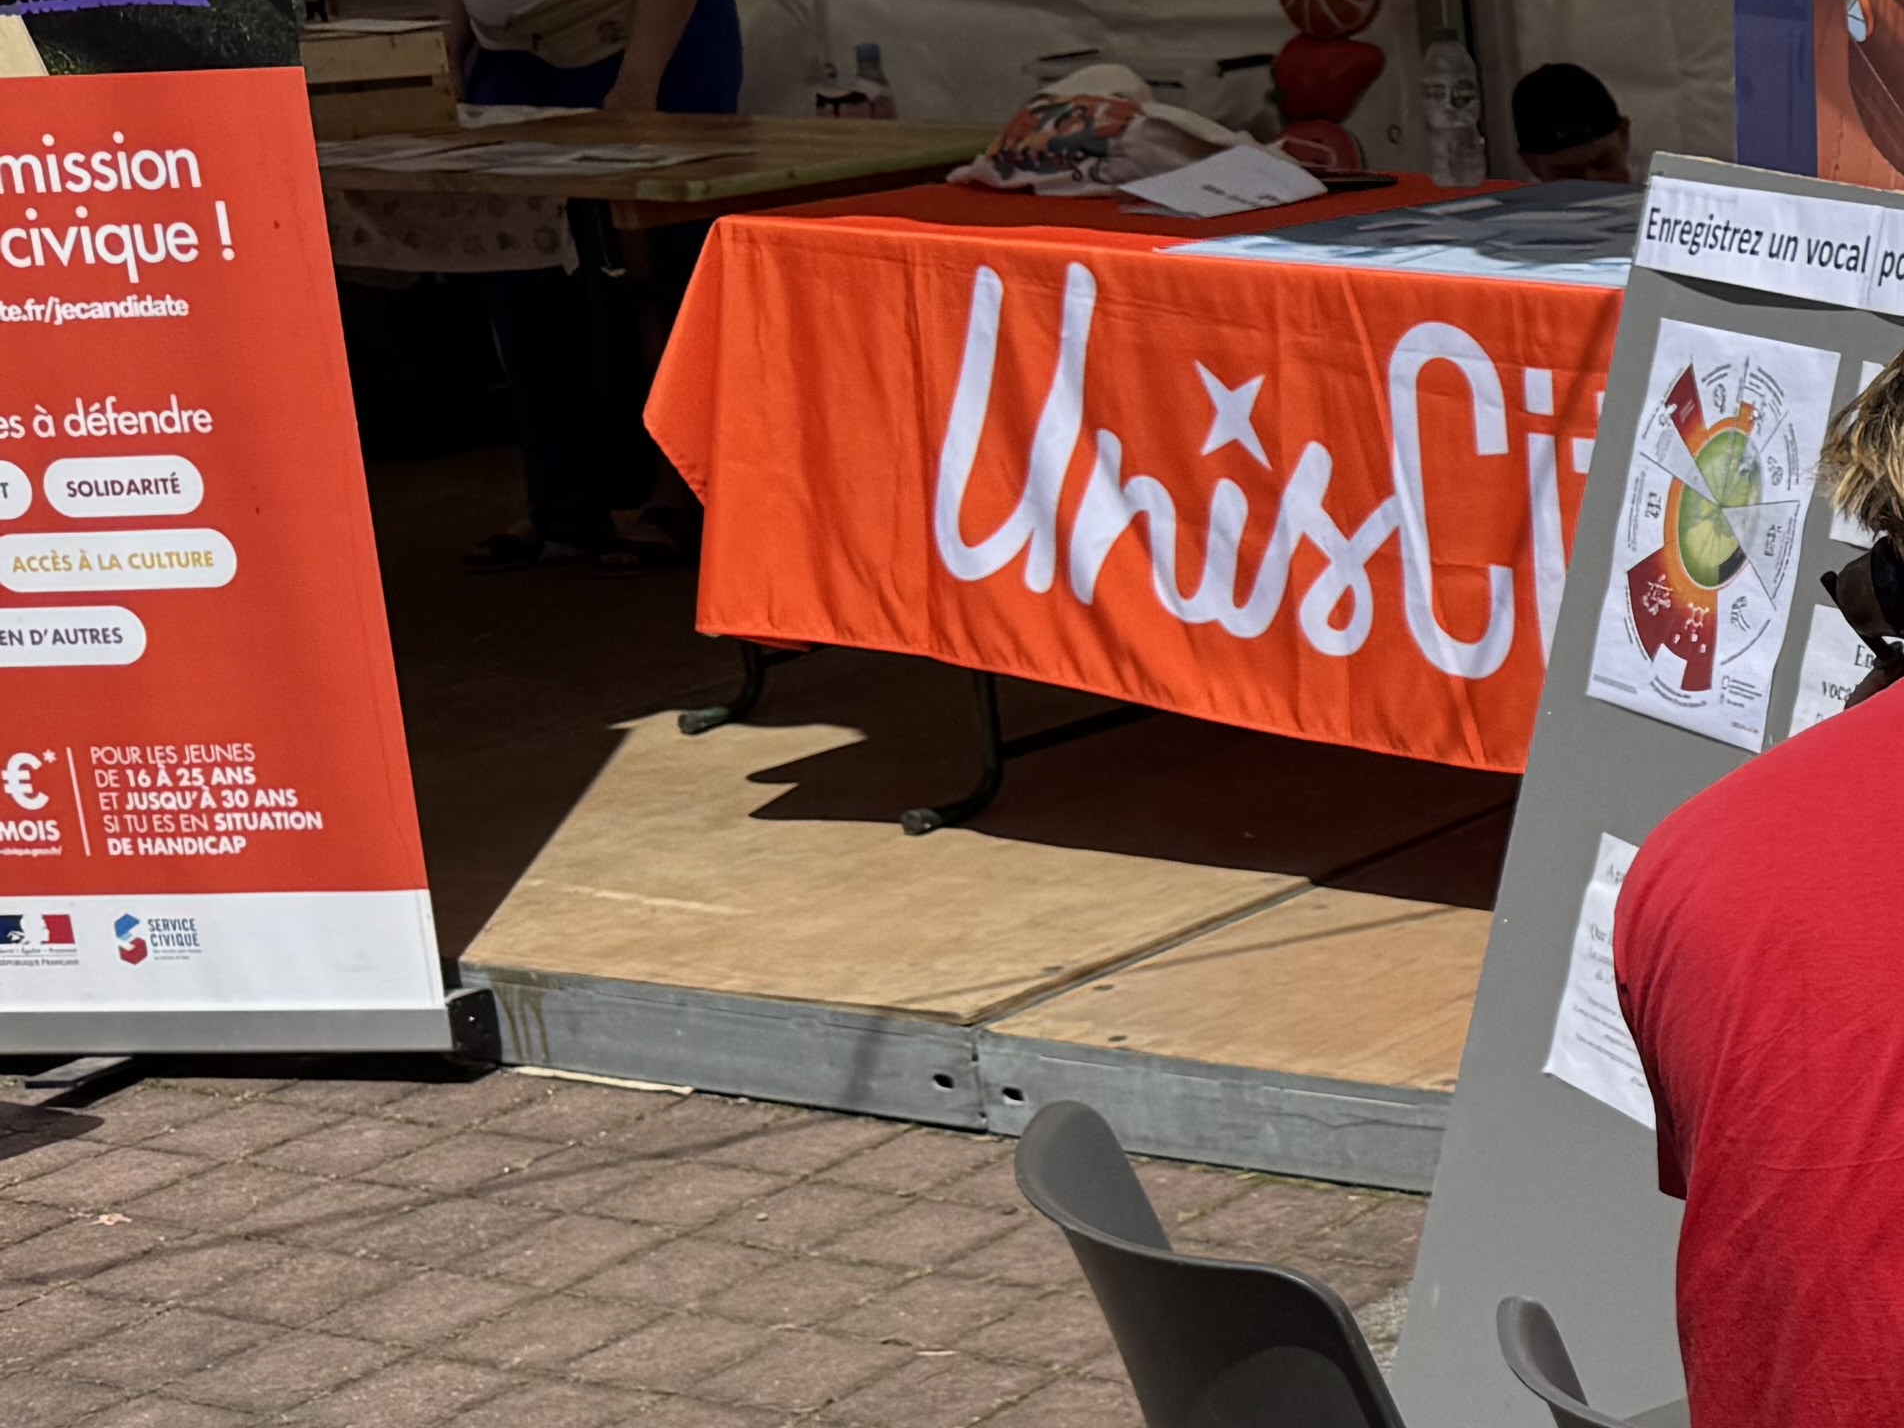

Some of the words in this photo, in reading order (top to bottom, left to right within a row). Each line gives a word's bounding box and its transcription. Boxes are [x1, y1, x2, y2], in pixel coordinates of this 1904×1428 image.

[0, 131, 202, 194] mission
[0, 205, 199, 283] civique
[215, 200, 235, 261] !
[1646, 207, 1761, 256] Enregistrez
[1768, 232, 1798, 262] un
[1806, 235, 1870, 273] vocal
[33, 404, 56, 438] à
[63, 393, 213, 438] défendre
[66, 472, 181, 498] SOLIDARITÉ
[12, 549, 72, 573] ACCÈS
[78, 548, 93, 572] À
[97, 553, 122, 572] LA
[127, 550, 214, 570] CULTURE
[30, 627, 123, 647] D'AUTRES
[90, 745, 143, 765] POUR
[146, 745, 178, 765] LES
[182, 743, 256, 764] JEUNES
[94, 769, 120, 788] DE
[125, 768, 152, 788] 16
[156, 763, 173, 787] À
[176, 768, 205, 786] 25
[210, 766, 257, 785] ANS
[98, 792, 120, 810] ET
[221, 789, 249, 809] 30
[254, 788, 298, 808] ANS
[0, 819, 61, 843] MOIS
[103, 814, 120, 834] SI
[123, 814, 148, 833] TU
[152, 814, 175, 833] ES
[179, 813, 209, 832] EN
[213, 811, 323, 832] SITUATION
[107, 837, 134, 856] DE
[137, 835, 247, 856] HANDICAP
[147, 917, 197, 932] SERVICE
[149, 932, 201, 948] CIVIQUE
